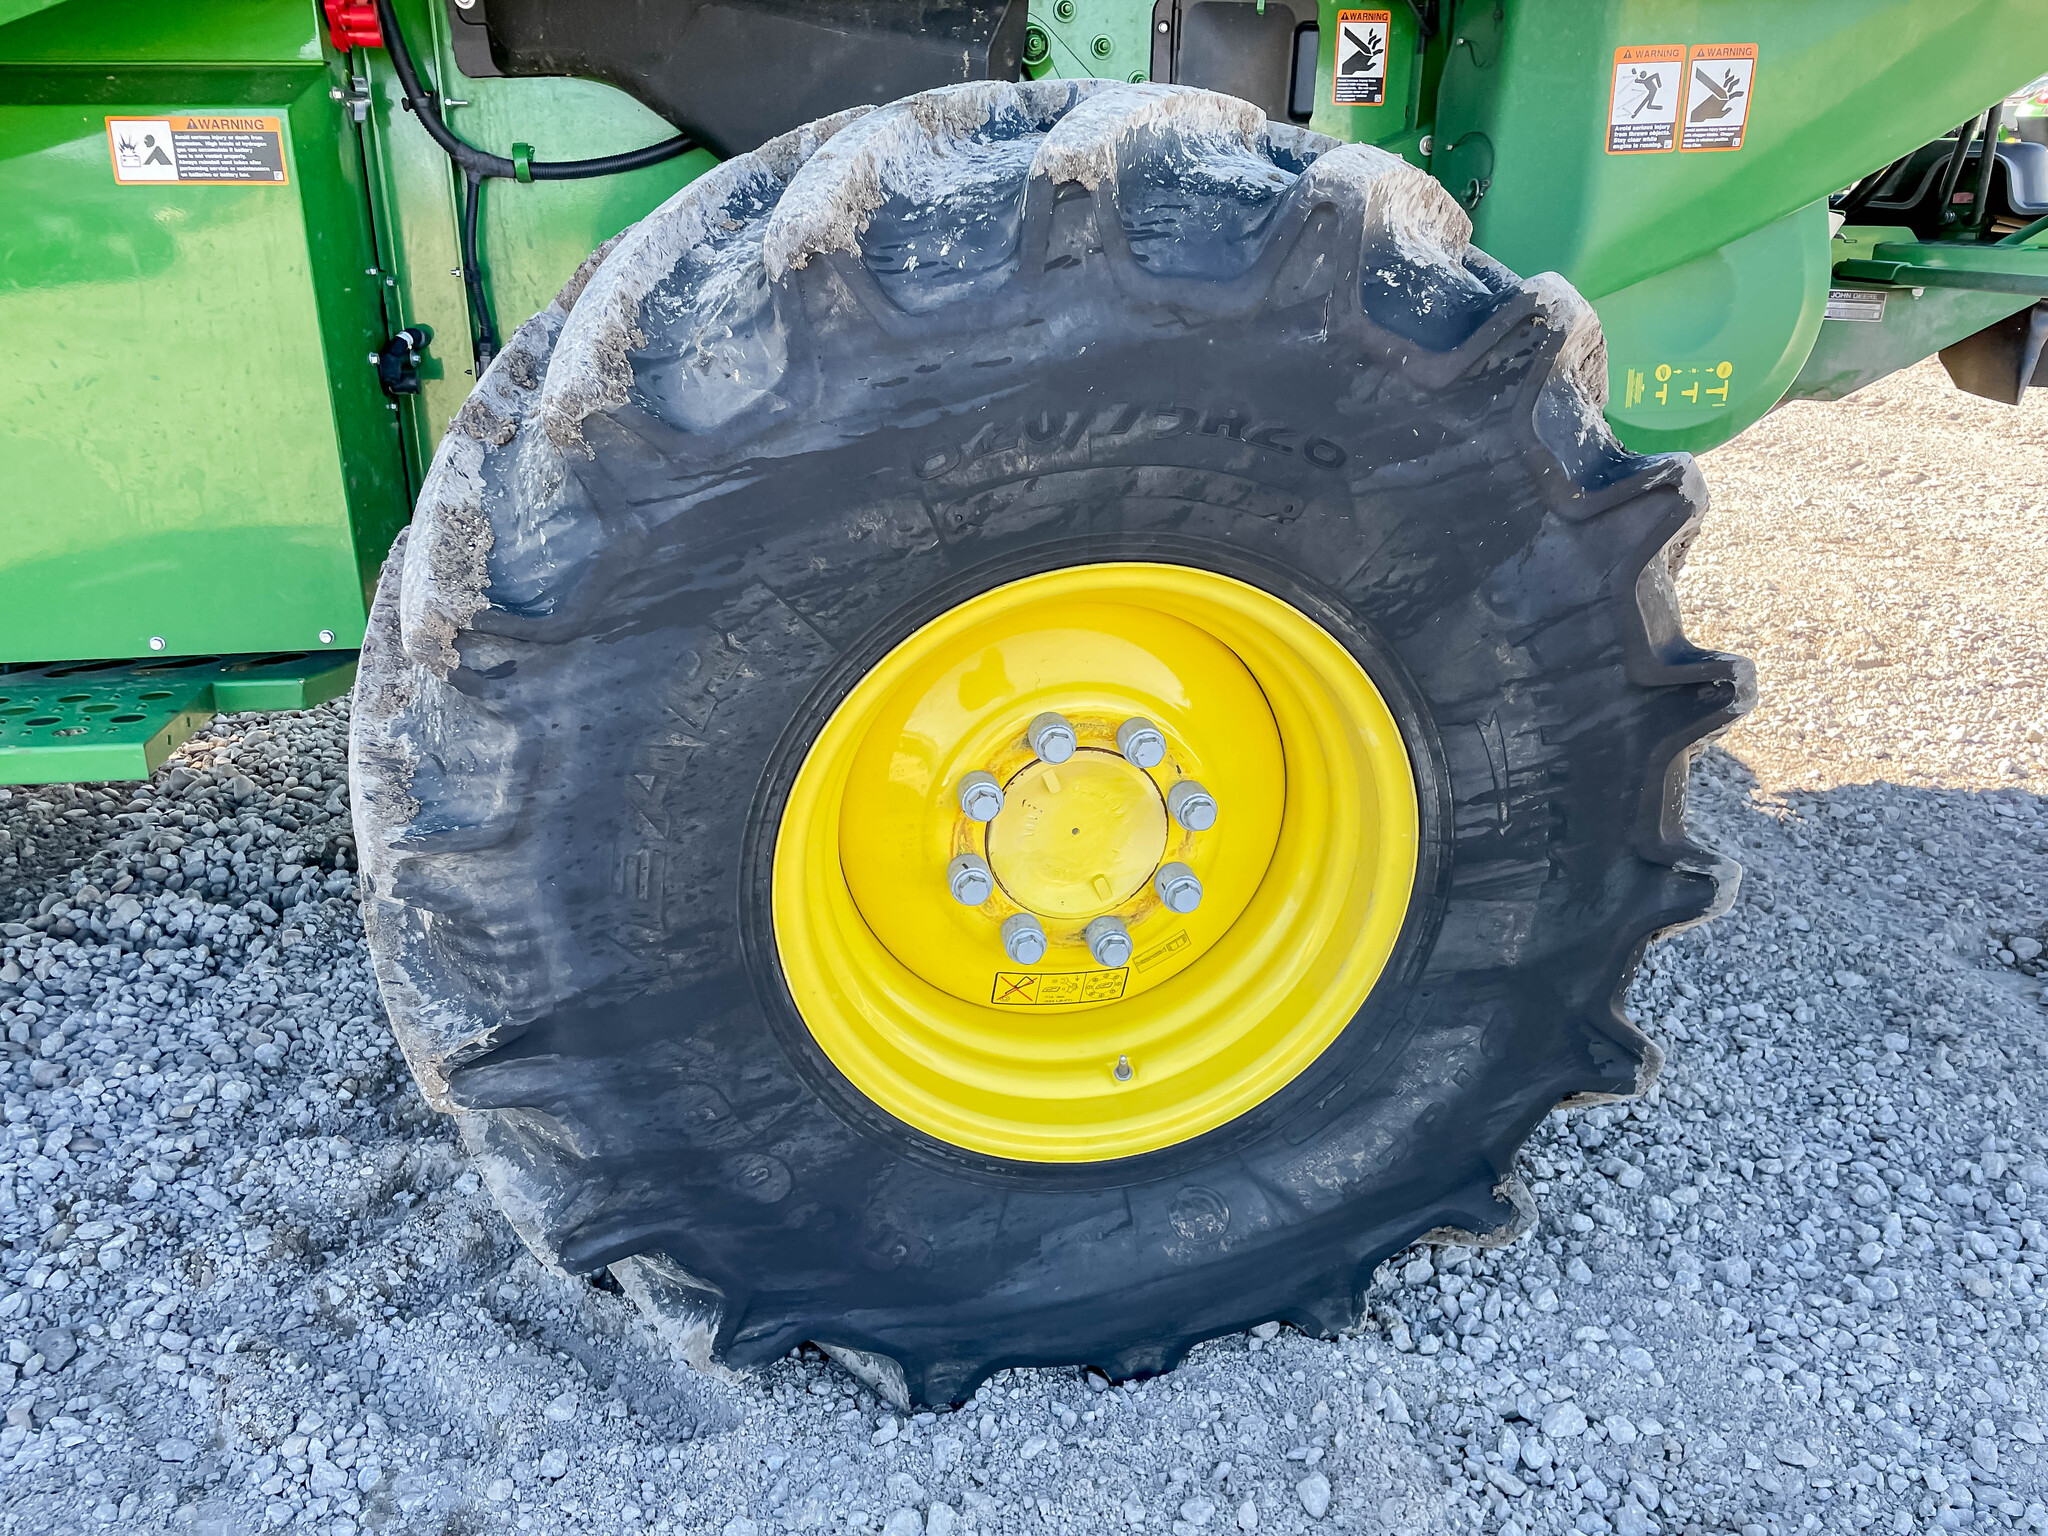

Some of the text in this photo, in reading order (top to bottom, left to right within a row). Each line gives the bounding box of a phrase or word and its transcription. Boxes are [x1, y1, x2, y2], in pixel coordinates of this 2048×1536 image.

[1636, 49, 1679, 58] WARNING
[1707, 48, 1752, 56] WARNING
[198, 119, 264, 130] WARNING
